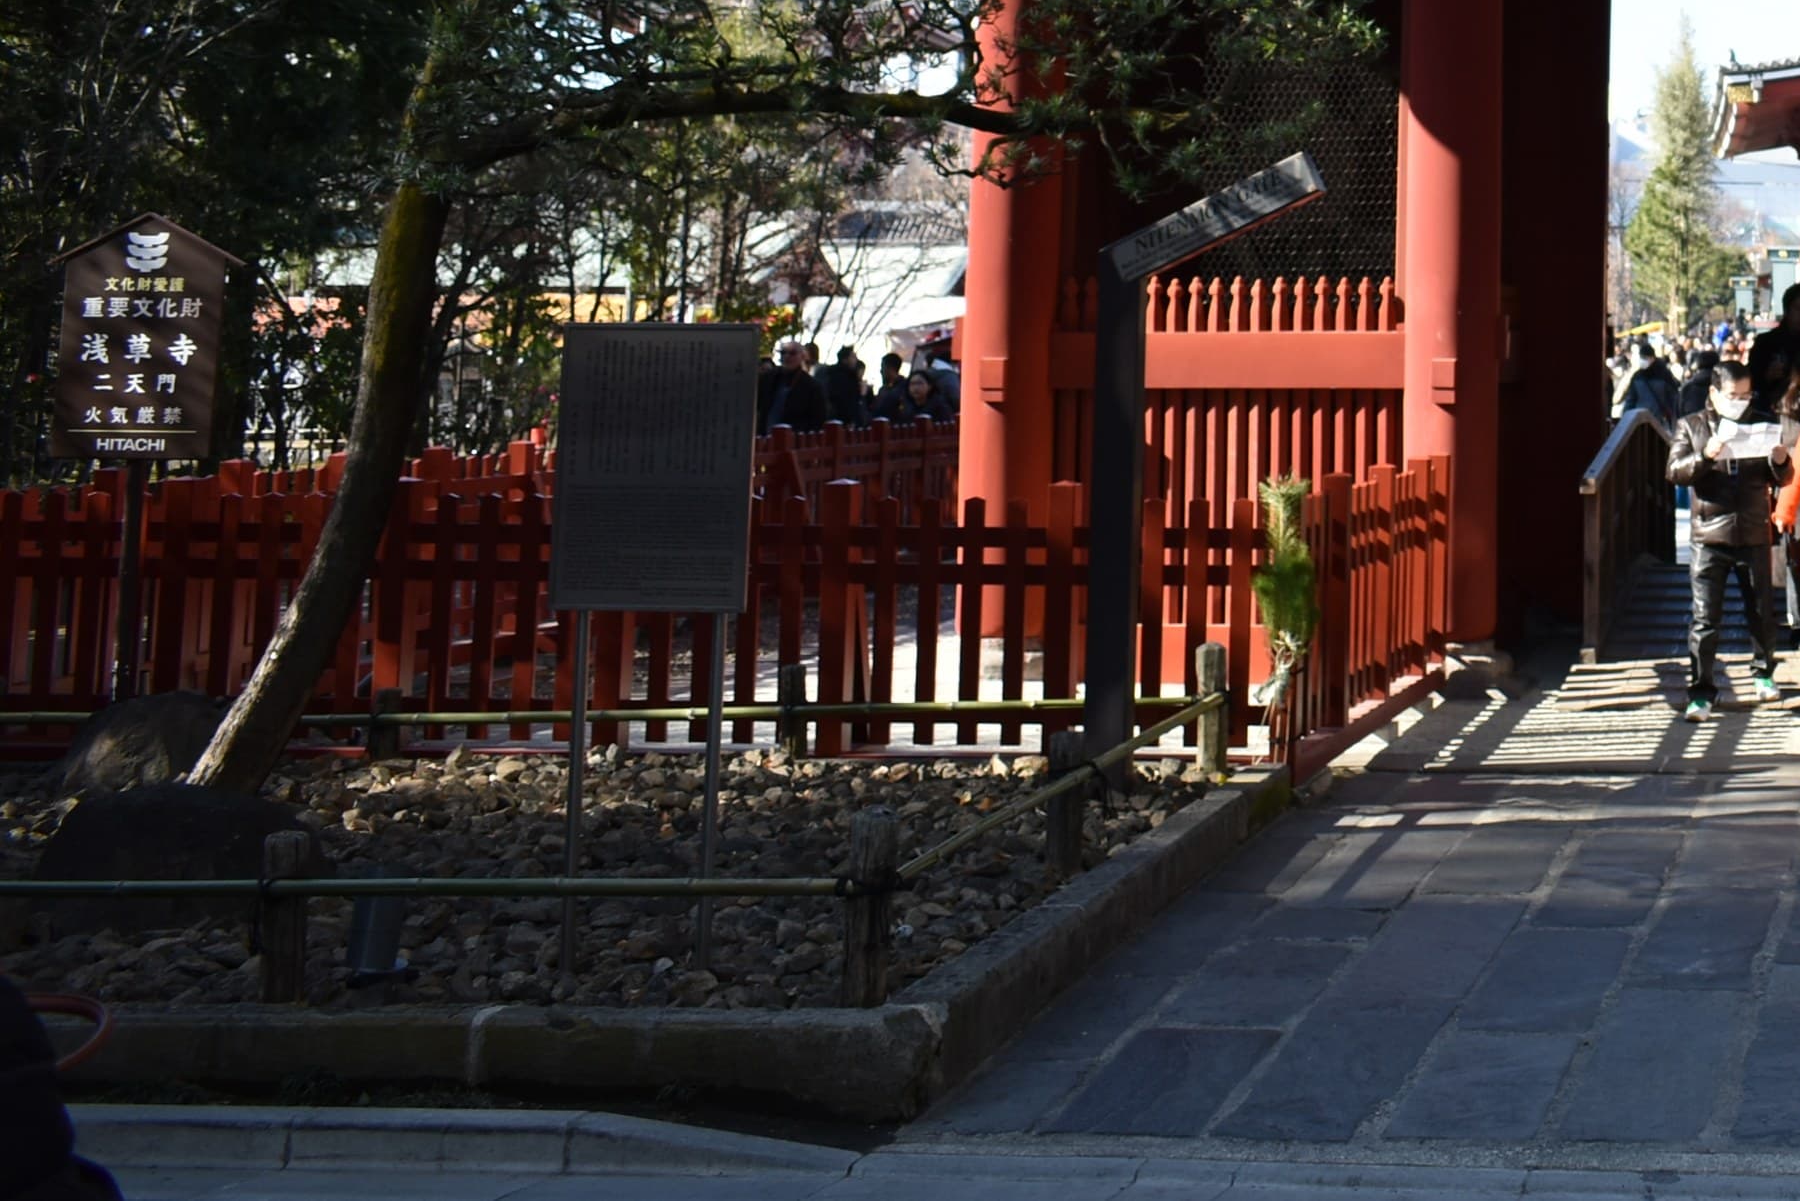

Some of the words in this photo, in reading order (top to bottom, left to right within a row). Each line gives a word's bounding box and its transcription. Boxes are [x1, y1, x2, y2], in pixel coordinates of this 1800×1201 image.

[104, 277, 185, 292] 文化財愛護
[82, 297, 203, 318] 重要文化財
[81, 333, 198, 366] 浅草寺
[93, 373, 177, 394] 二天門
[84, 406, 183, 424] 火気厳禁
[96, 437, 166, 452] HITACHI
